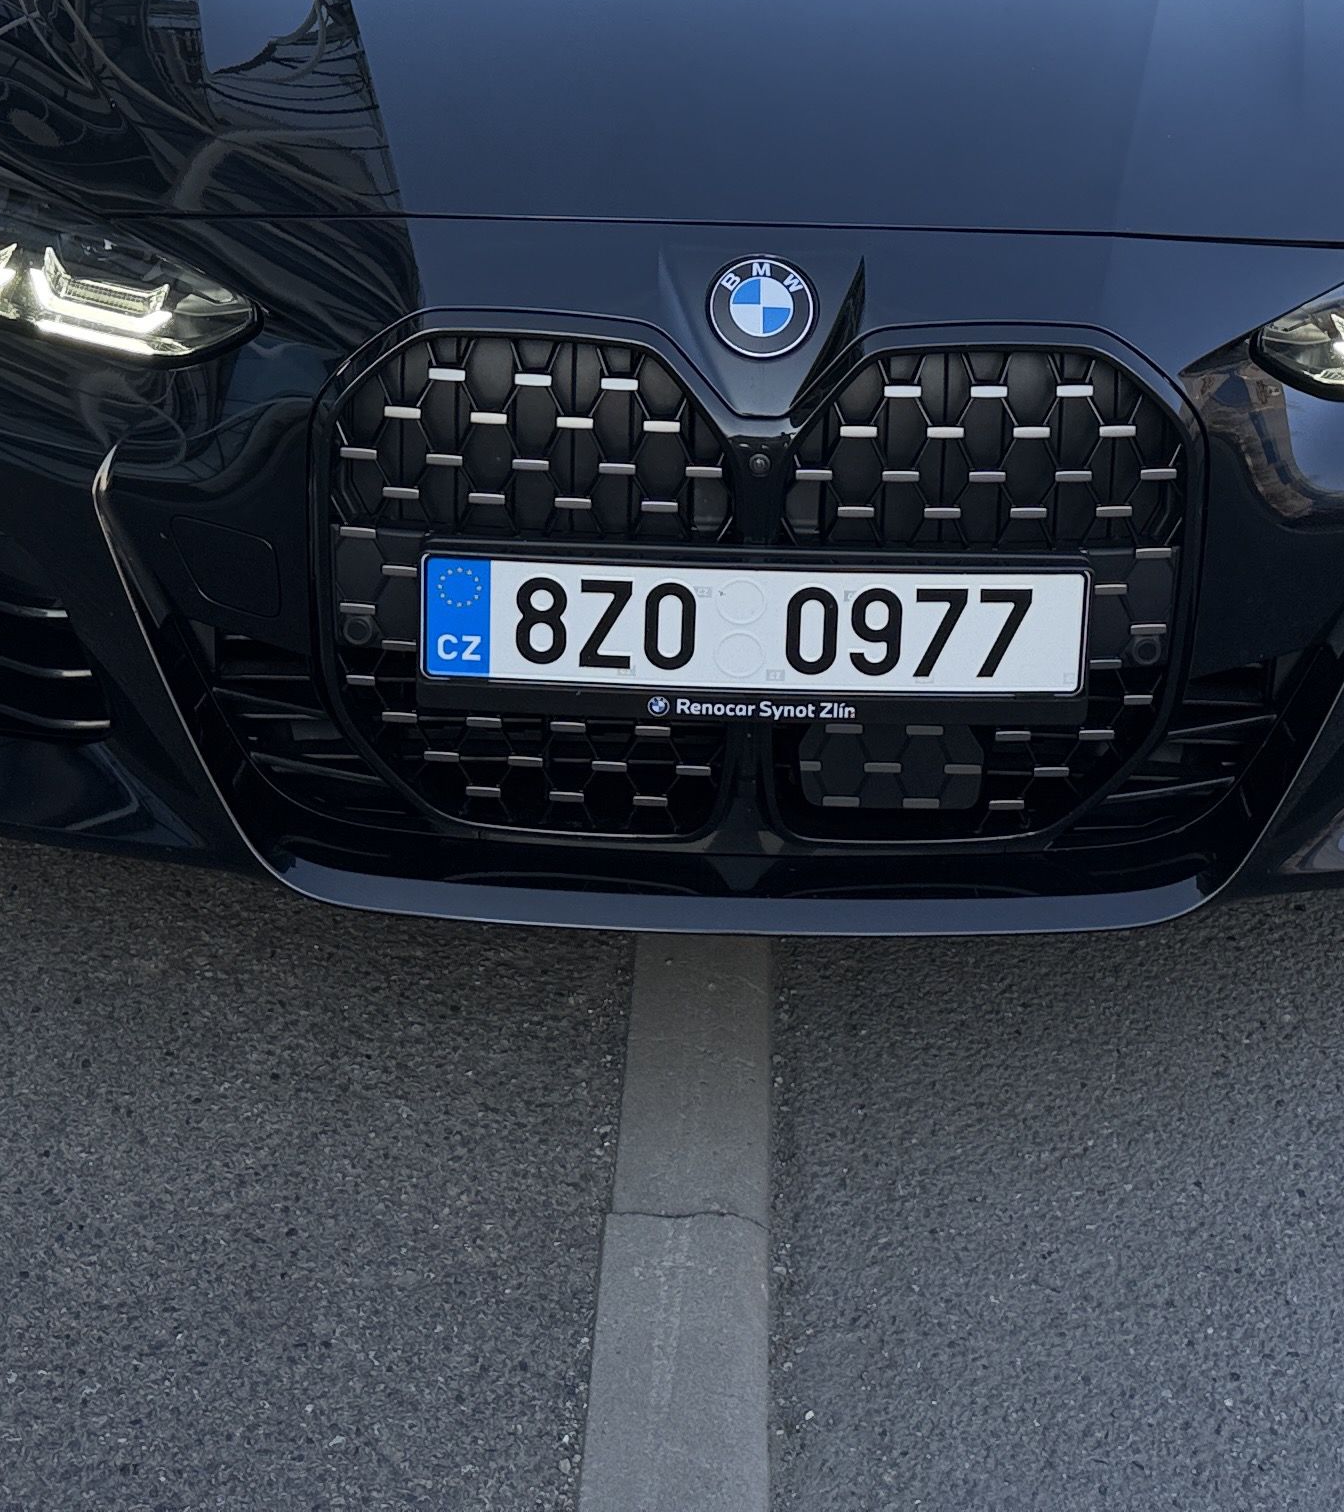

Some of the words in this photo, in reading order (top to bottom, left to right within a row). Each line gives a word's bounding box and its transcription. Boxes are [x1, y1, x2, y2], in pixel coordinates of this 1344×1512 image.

[721, 262, 804, 293] BMW
[515, 577, 696, 670] 8Z0
[785, 586, 1034, 677] 0977
[437, 634, 482, 662] CZ
[676, 698, 756, 716] Renocar
[759, 701, 815, 720] Synot
[819, 702, 856, 719] Zlín
